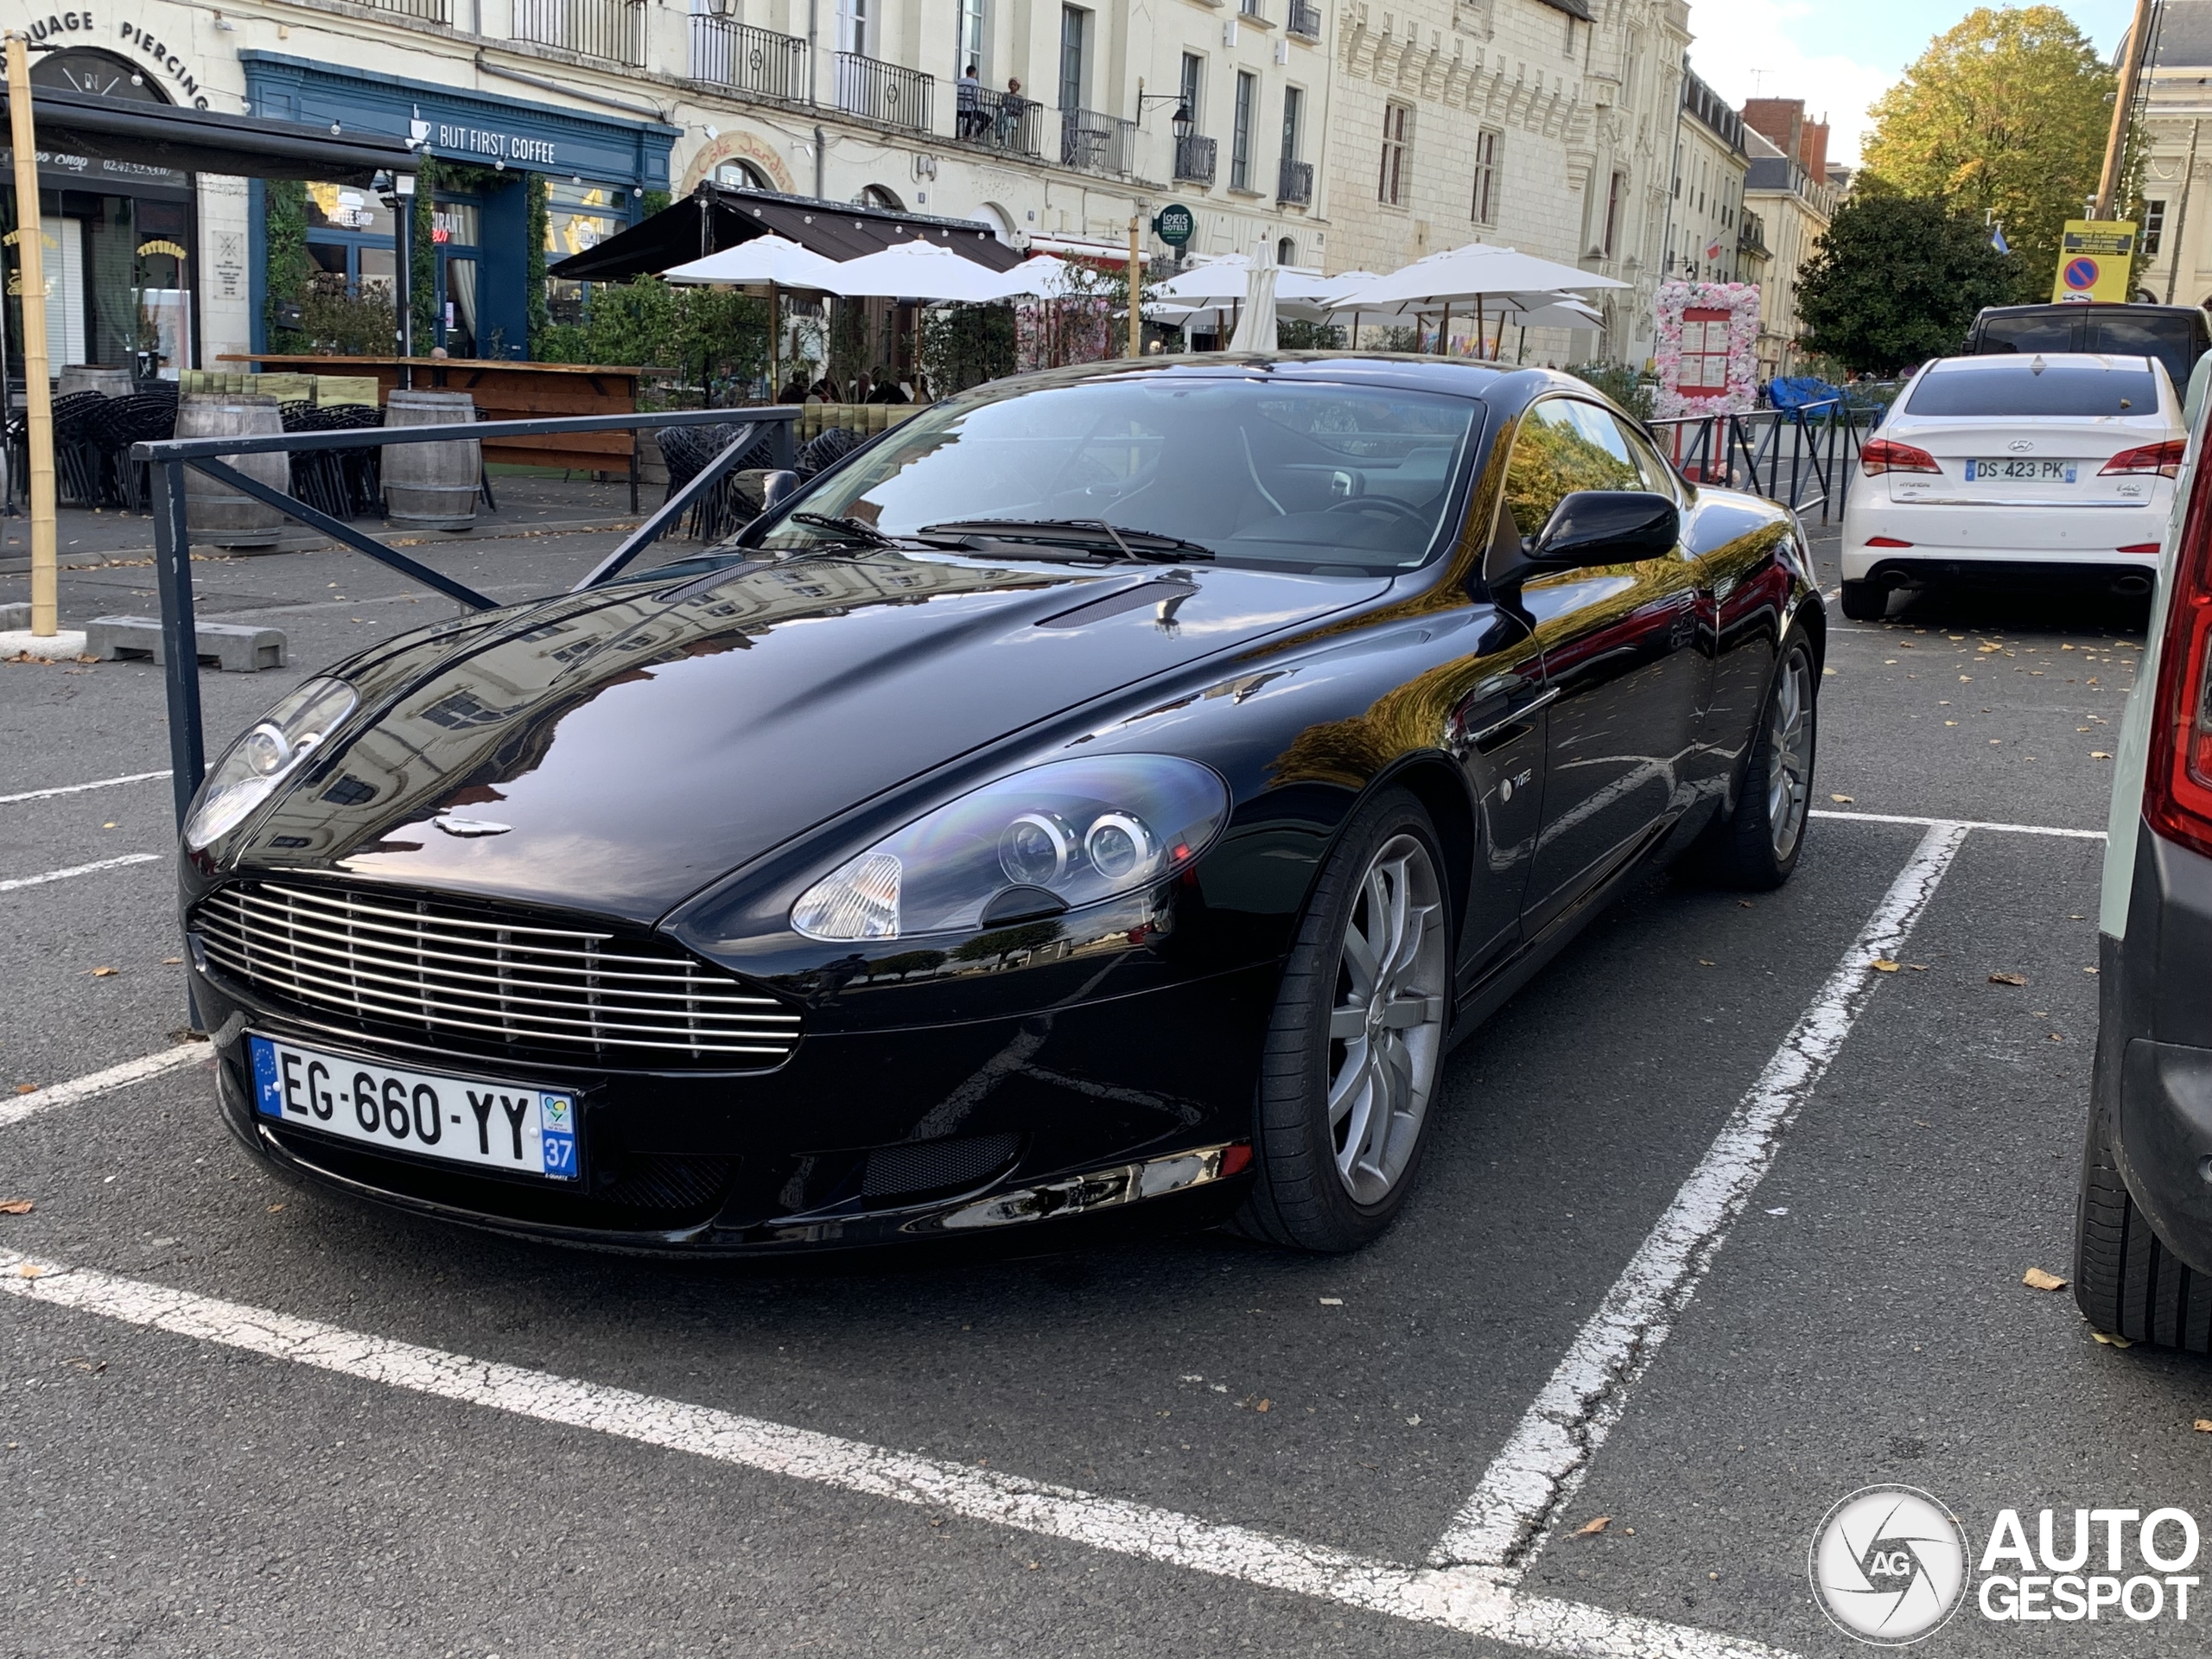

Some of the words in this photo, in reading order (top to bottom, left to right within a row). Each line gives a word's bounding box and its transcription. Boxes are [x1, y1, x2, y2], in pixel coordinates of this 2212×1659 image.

[121, 20, 209, 111] PIERCING
[440, 124, 466, 149] BUT
[511, 137, 556, 164] COFFEE
[355, 211, 374, 226] SHOP
[1977, 461, 2064, 478] DS-423-PK
[264, 1084, 272, 1102] F
[281, 1052, 529, 1160] EG-660-YY
[545, 1137, 573, 1168] 37
